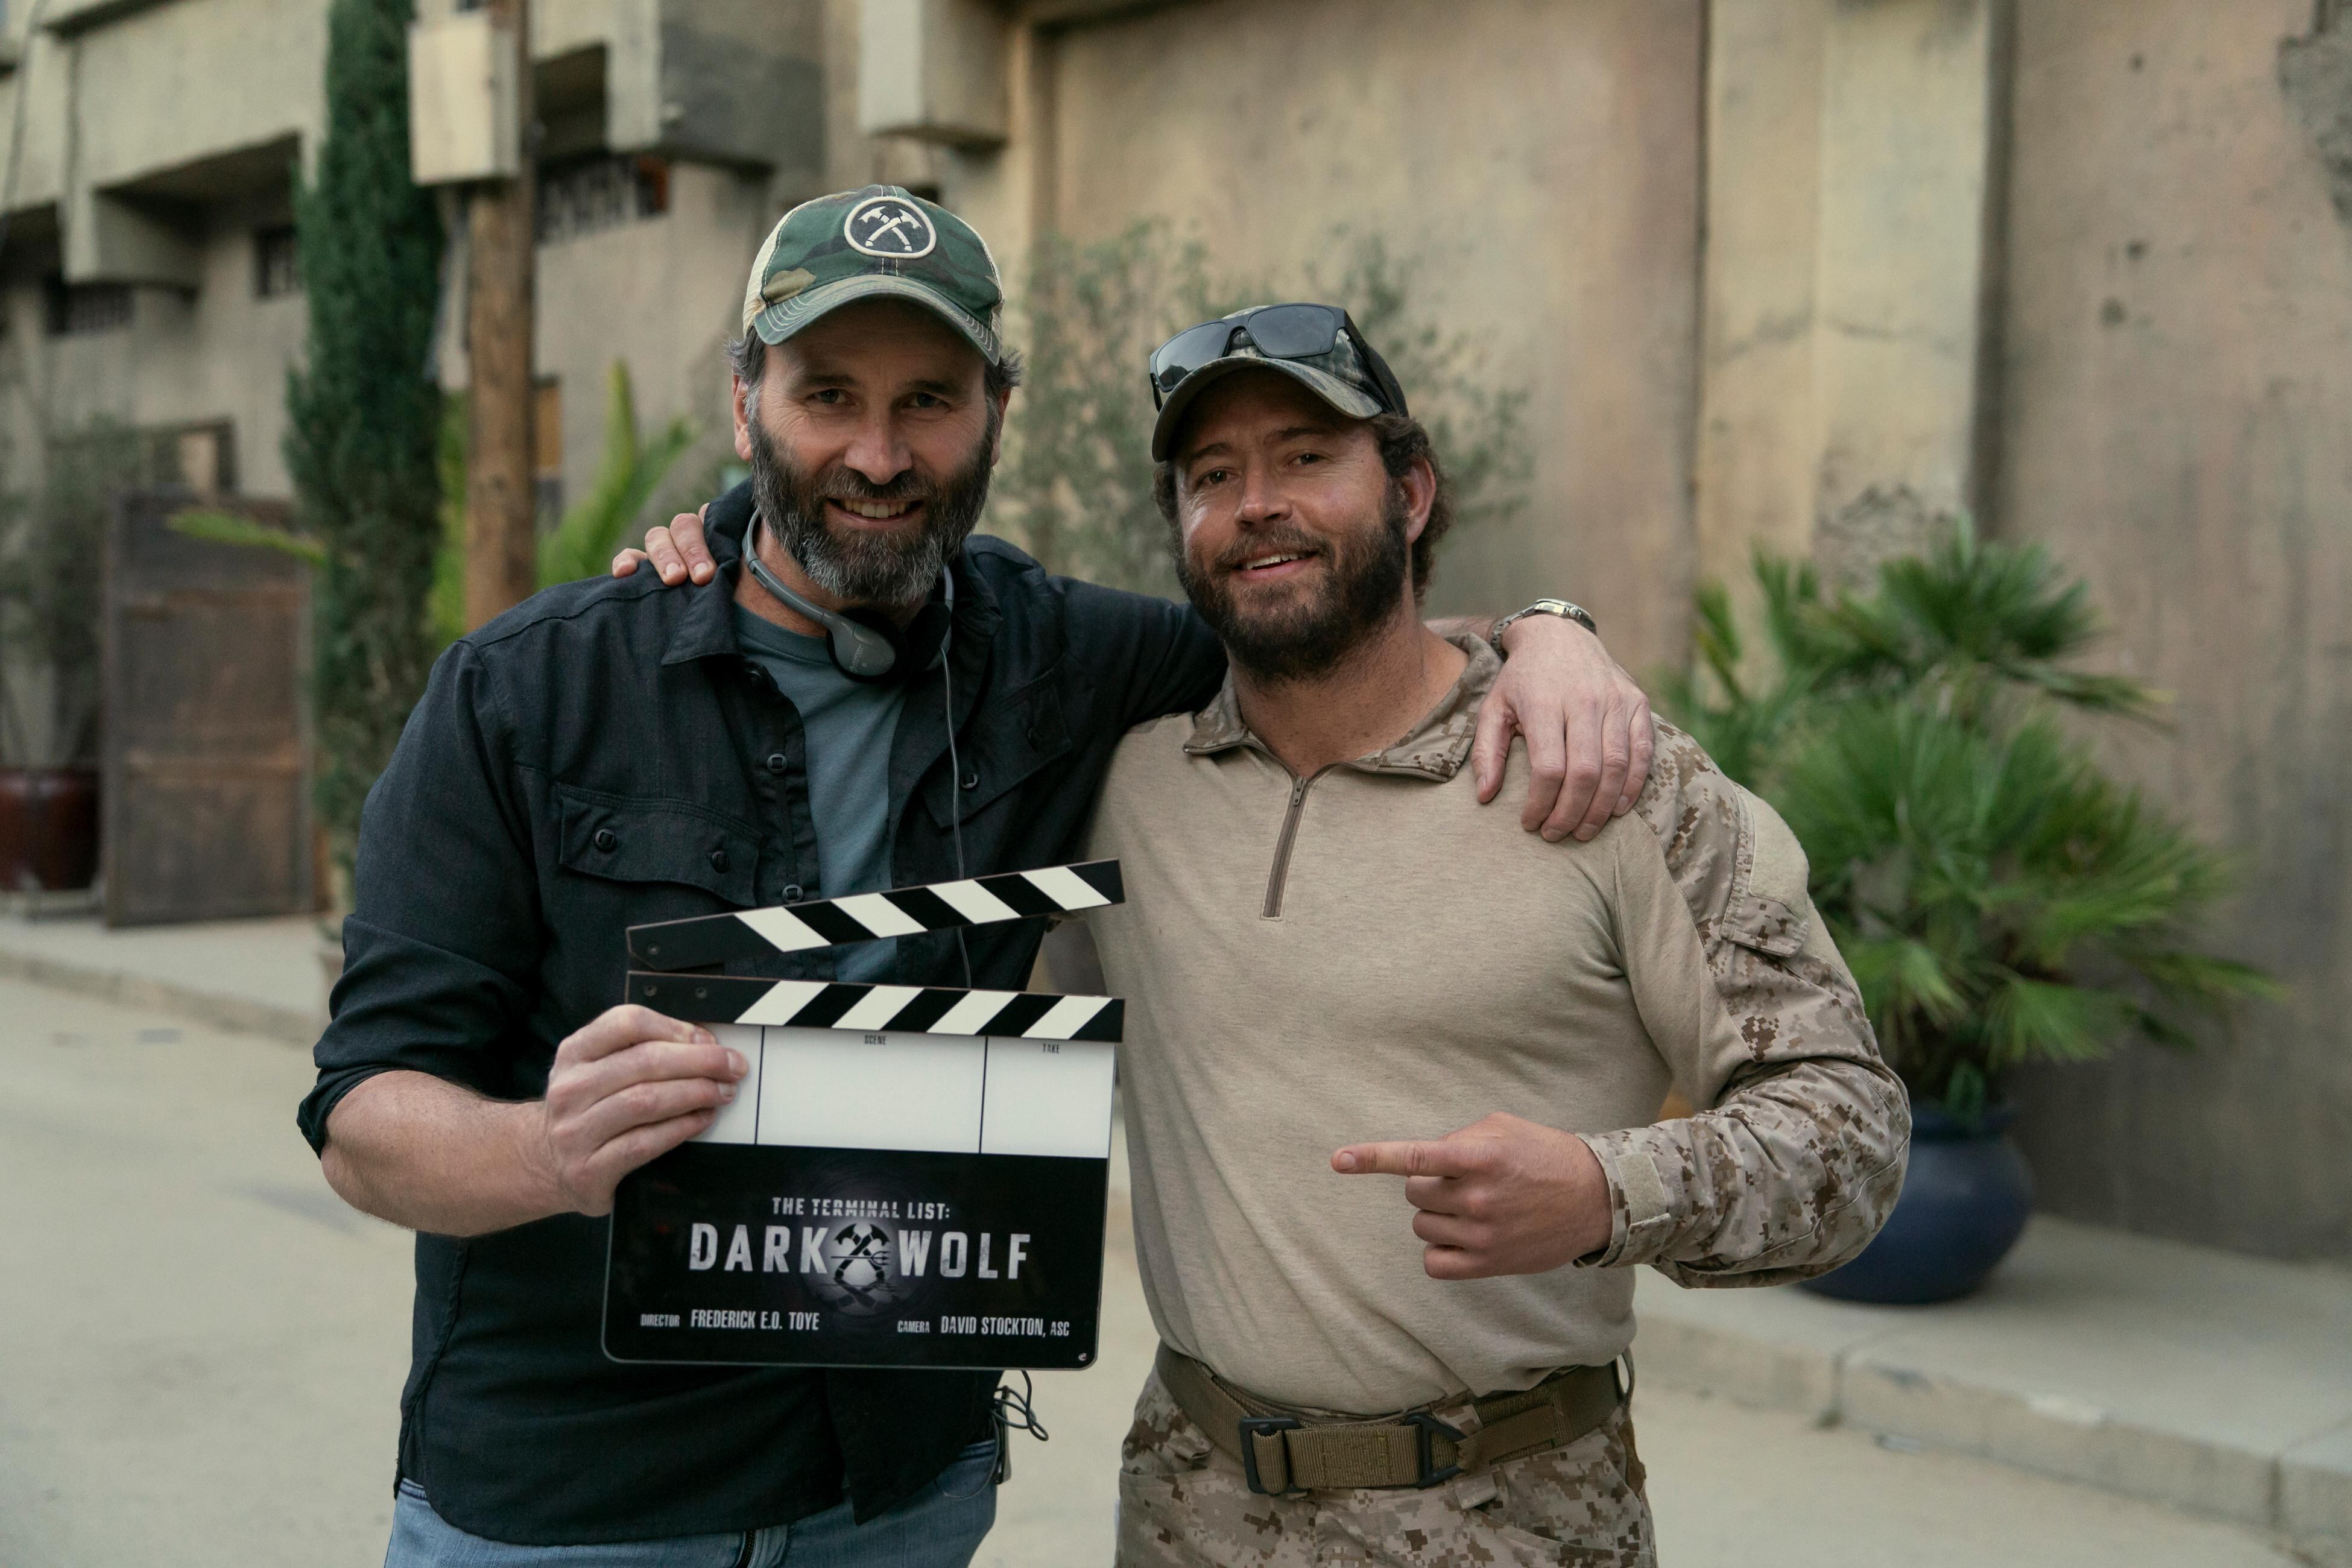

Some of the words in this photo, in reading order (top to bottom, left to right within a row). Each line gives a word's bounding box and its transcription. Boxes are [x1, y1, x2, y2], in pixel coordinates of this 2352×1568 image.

[864, 1034, 887, 1045] SCENE
[1043, 1043, 1060, 1054] TAKE
[773, 1197, 805, 1215] THE
[812, 1198, 900, 1219] TERMINAL
[908, 1202, 950, 1219] LIST:
[689, 1223, 829, 1274] DARK
[898, 1230, 1031, 1279] WOLF
[640, 1314, 680, 1327] DIRECTOR
[691, 1309, 756, 1329] FREDERICK
[760, 1311, 783, 1330] E.O.
[789, 1312, 820, 1330] TOYE
[897, 1320, 930, 1333] CAMERA
[941, 1316, 977, 1335] DAVID
[981, 1317, 1046, 1338] STOCKTON,
[1050, 1321, 1070, 1336] ASC
